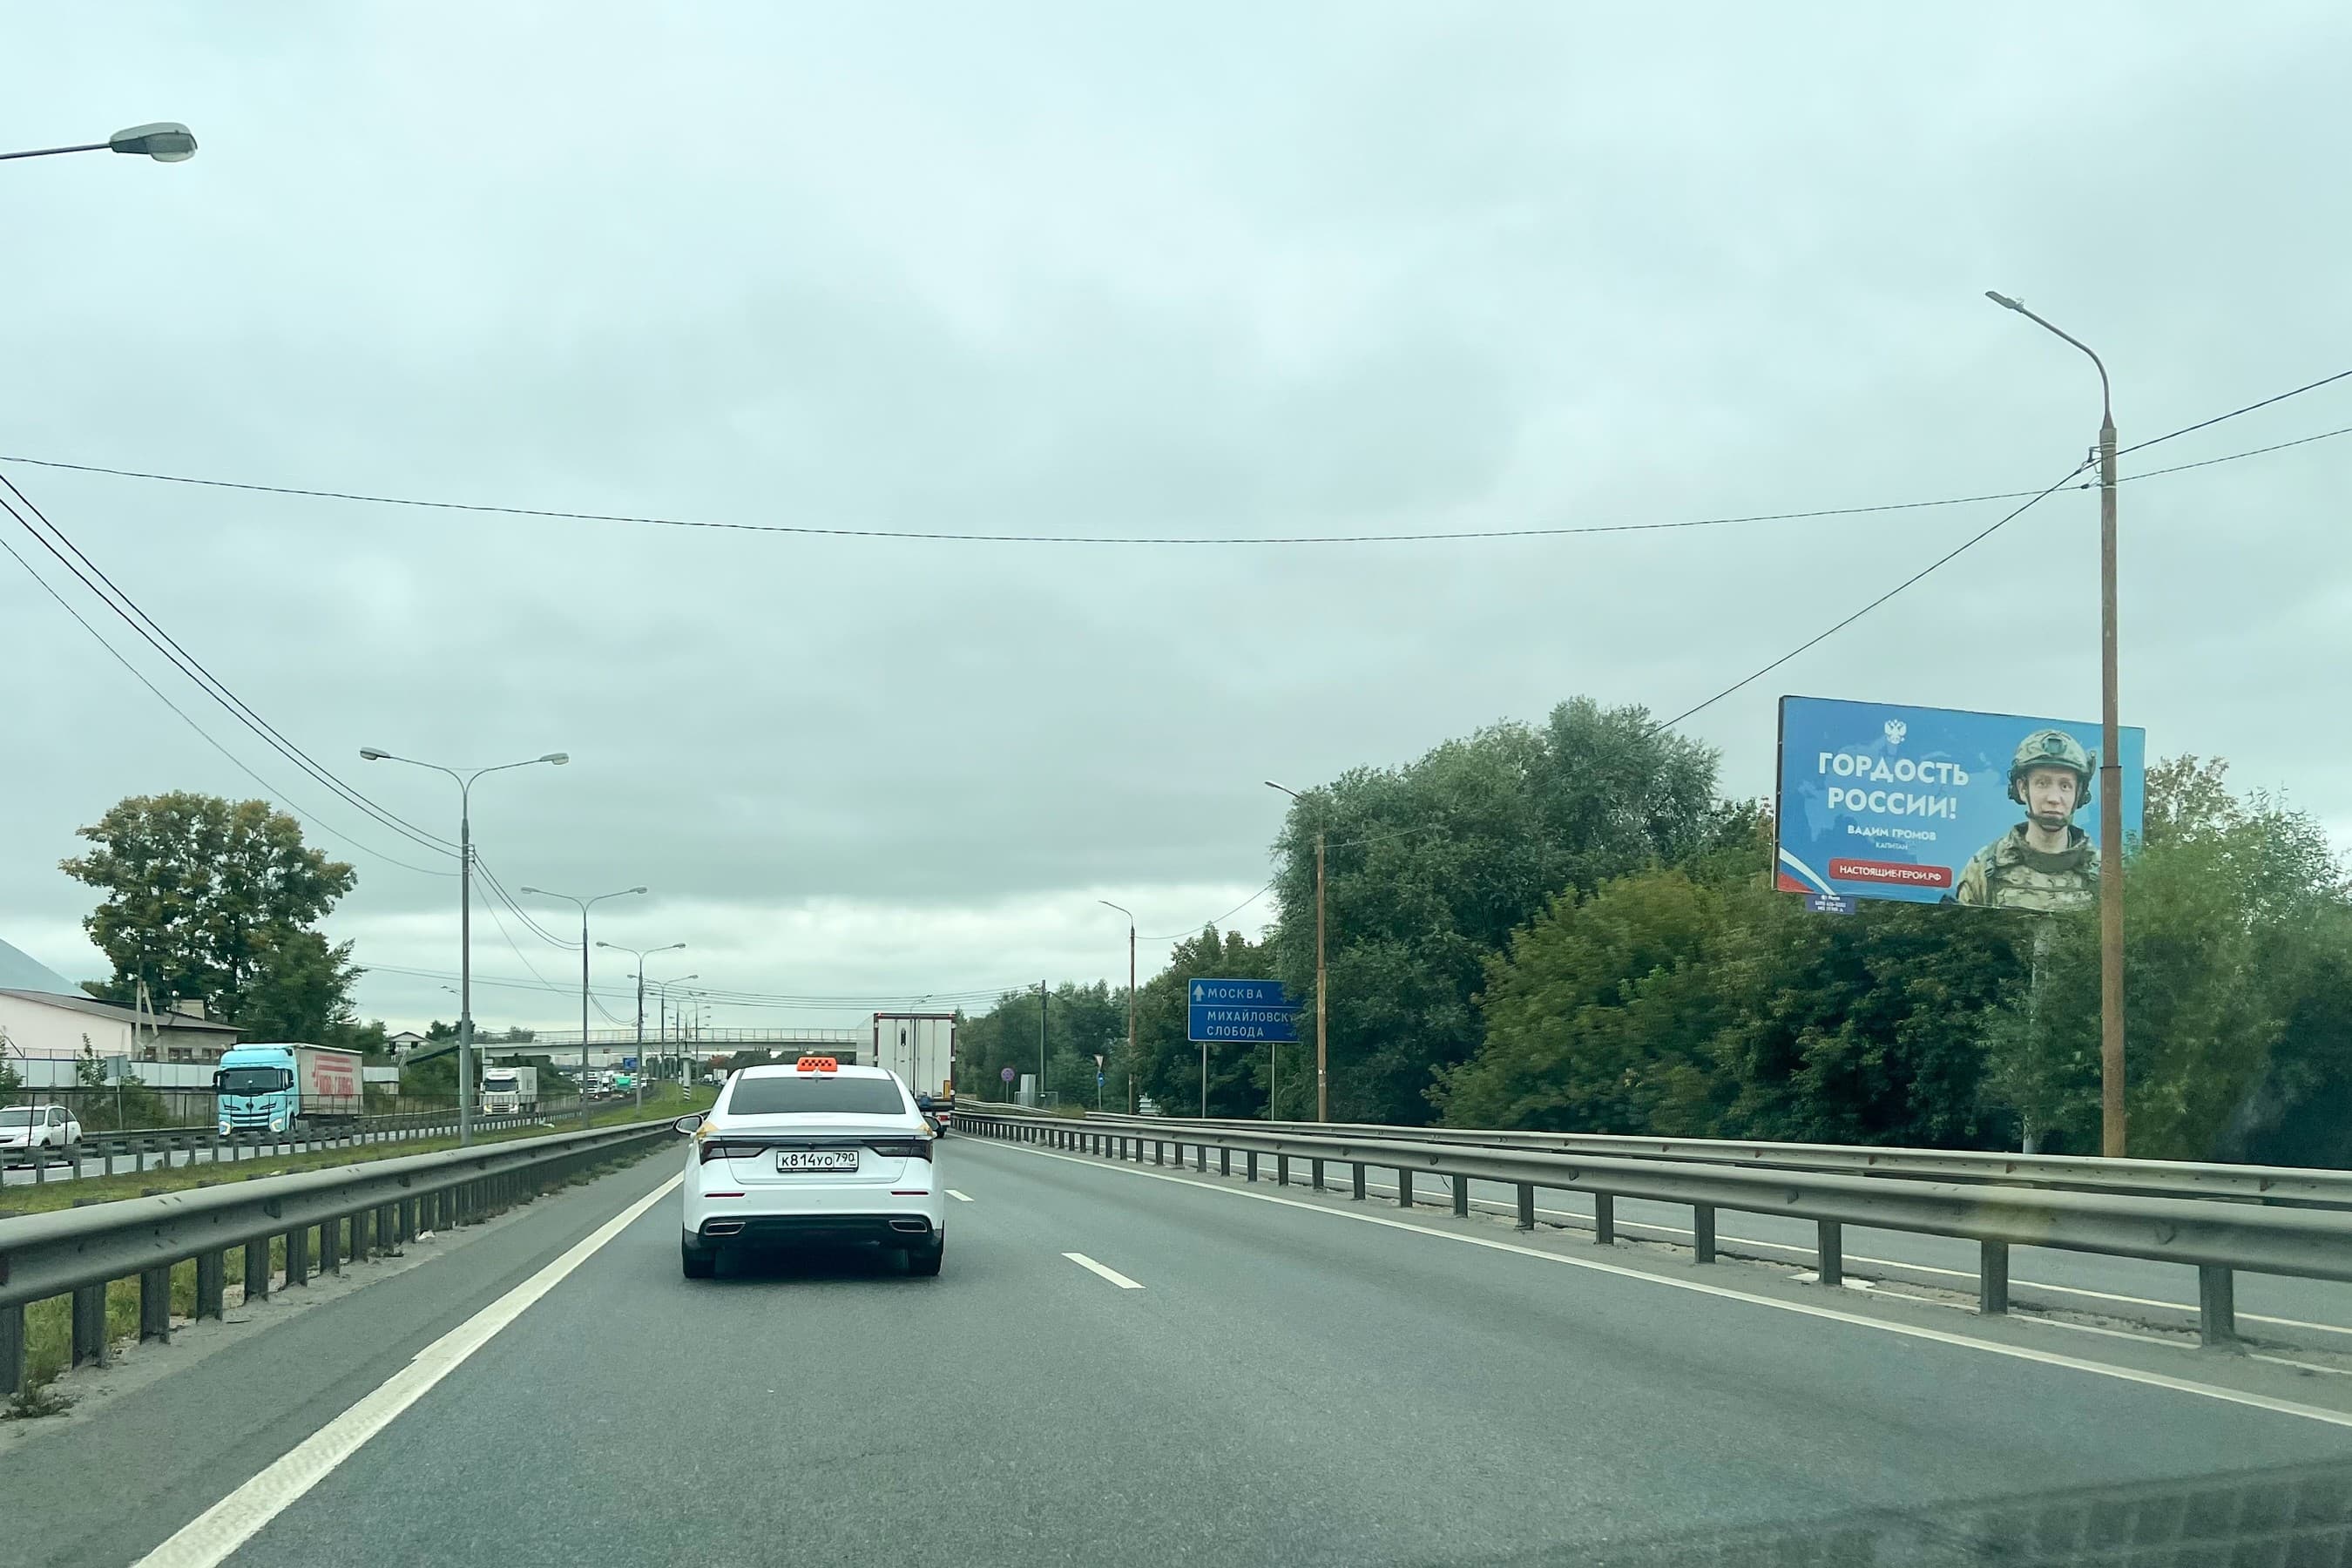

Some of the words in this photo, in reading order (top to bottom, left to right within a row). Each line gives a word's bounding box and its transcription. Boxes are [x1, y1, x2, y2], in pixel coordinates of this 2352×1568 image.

[1818, 752, 1970, 786] ГОРДОСТЬ
[1828, 787, 1957, 819] РОССИИ!
[1848, 825, 1889, 836] ВАДИМ
[1892, 828, 1936, 841] ГРОМОВ
[1876, 841, 1909, 850] КАПИТАН
[1207, 988, 1263, 999] МОСКВА
[1207, 1009, 1294, 1023] МИХАЙЛОВСК
[1206, 1026, 1264, 1038] СЛОБОДА
